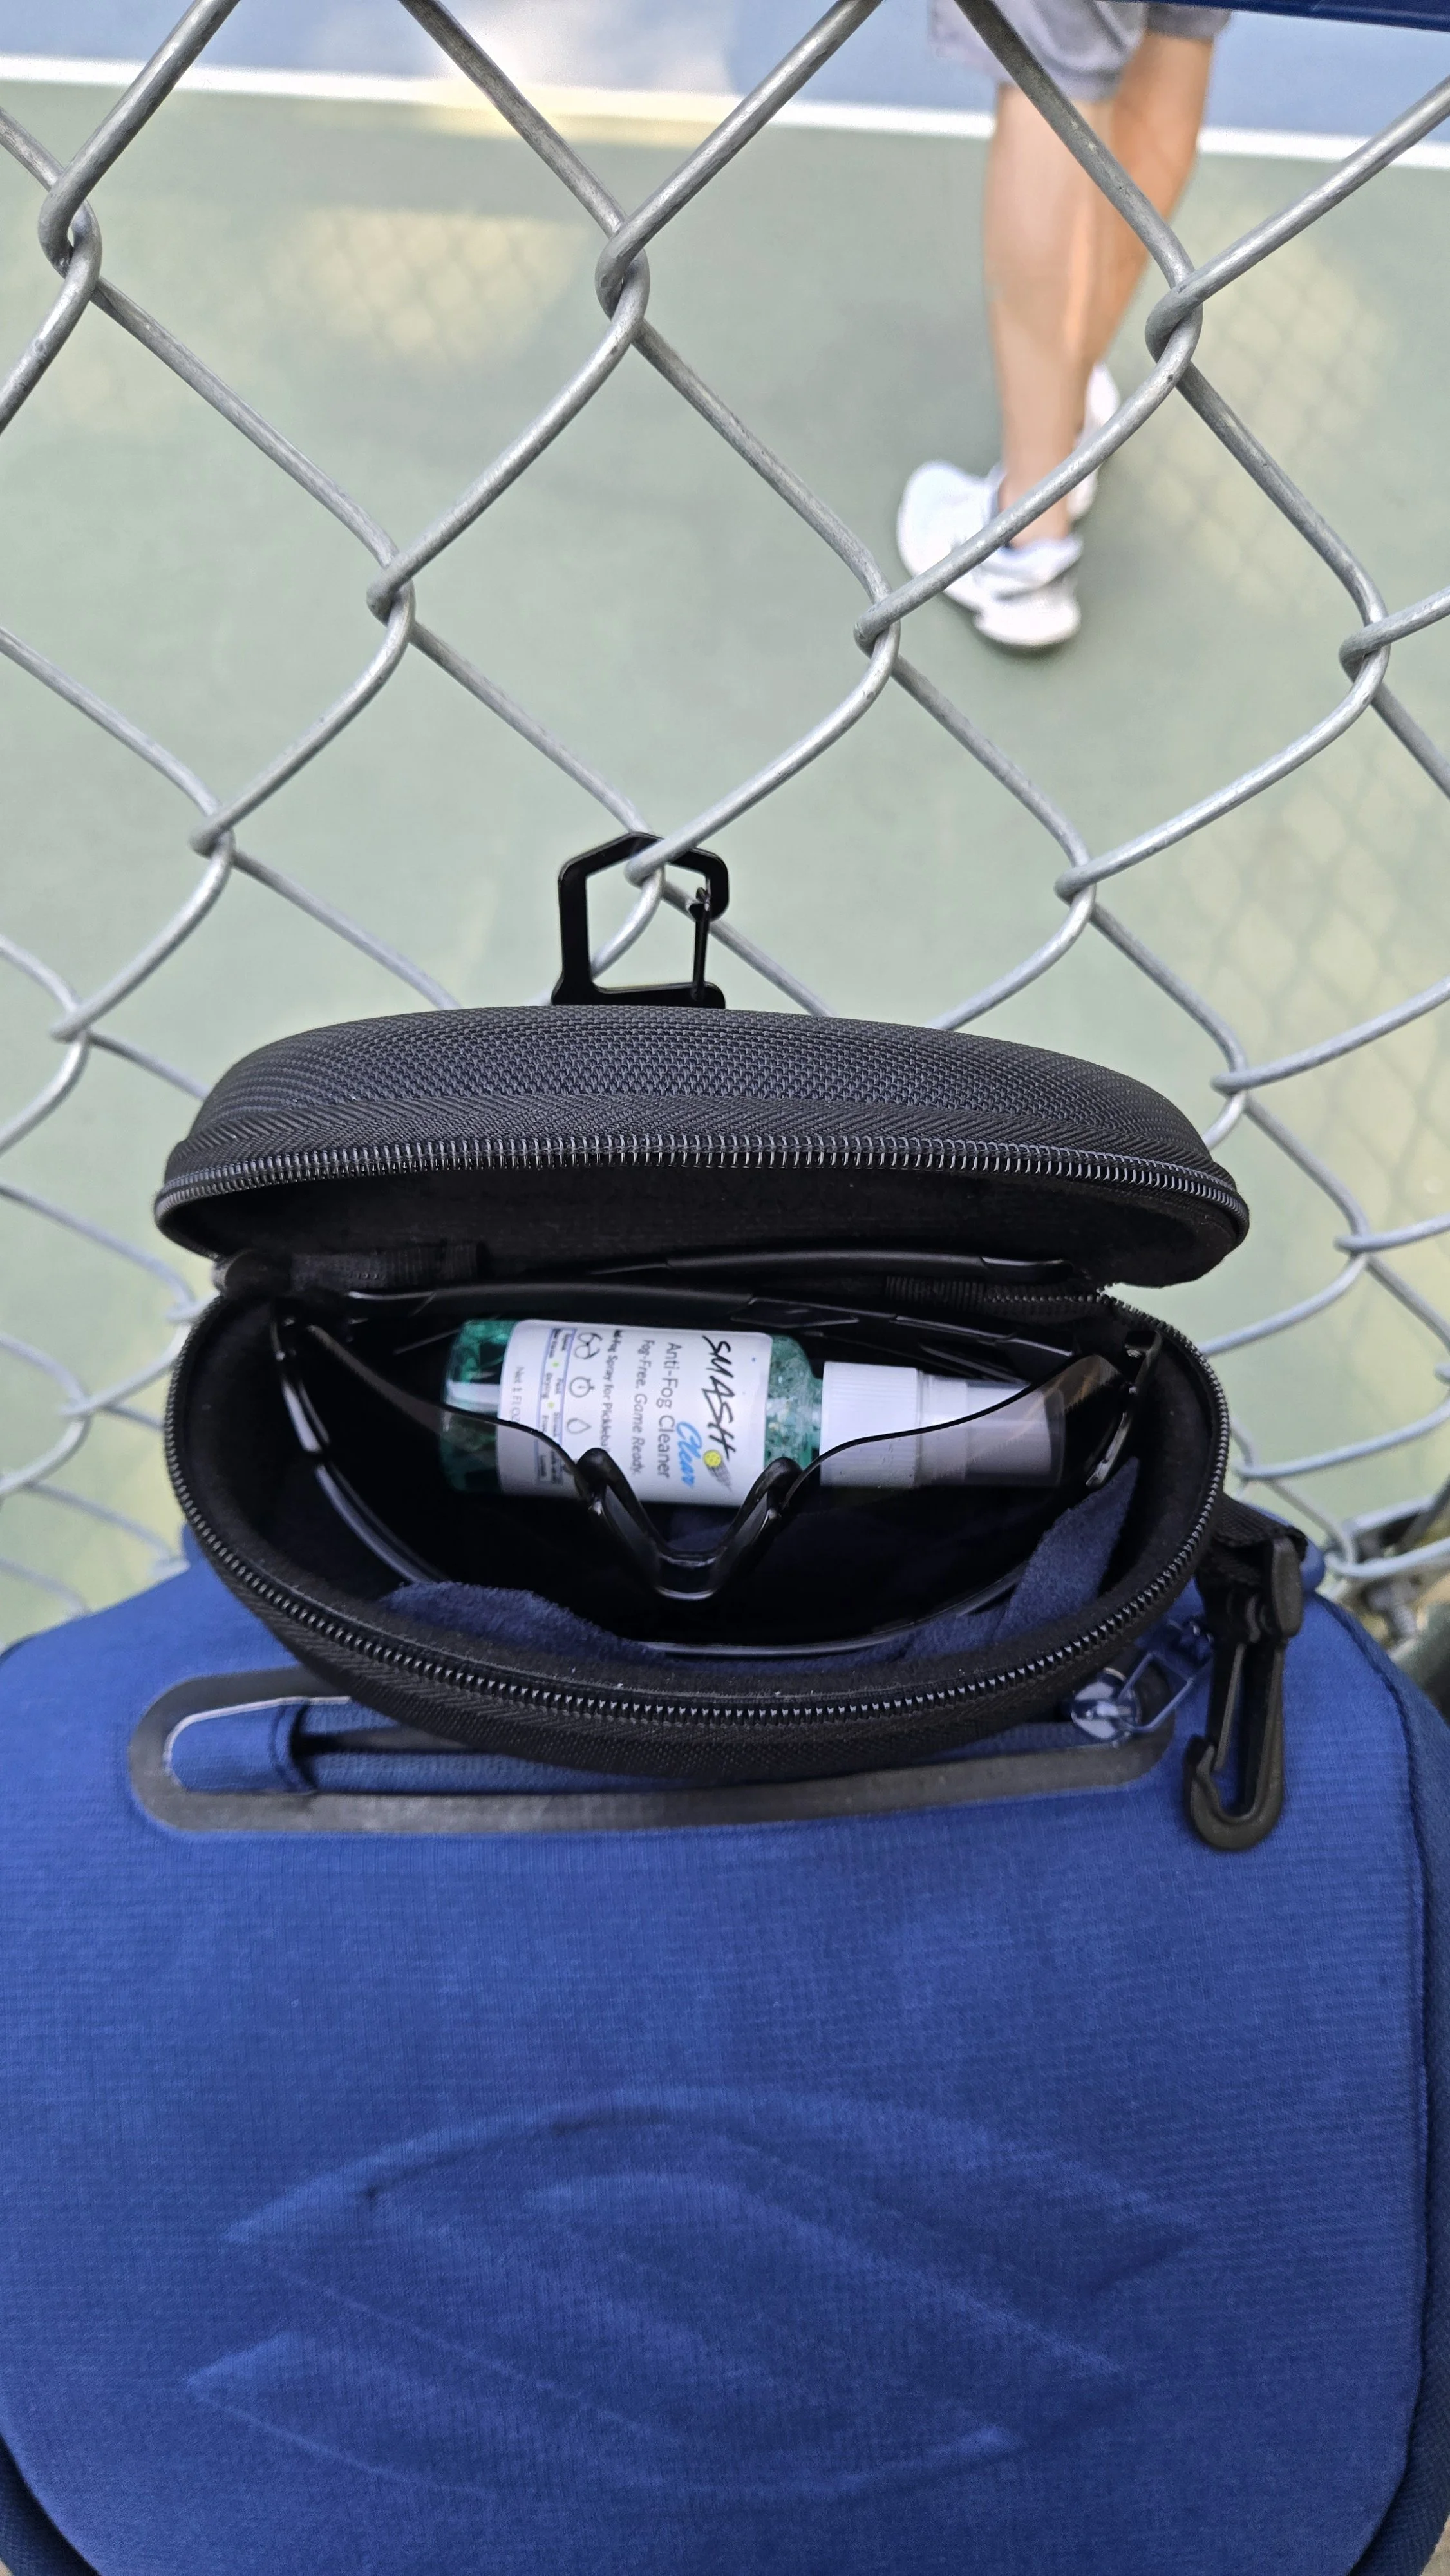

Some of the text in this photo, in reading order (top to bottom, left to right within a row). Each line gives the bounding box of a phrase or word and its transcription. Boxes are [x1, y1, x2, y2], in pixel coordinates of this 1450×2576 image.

[603, 1354, 618, 1381] Spray
[636, 1339, 655, 1389] Fog-Free.
[603, 1384, 614, 1400] for
[632, 1393, 648, 1434] Game
[656, 1342, 683, 1479] Anti-Fog Cleaner
[702, 1335, 736, 1461] SMASH
[676, 1422, 702, 1489] Clear
